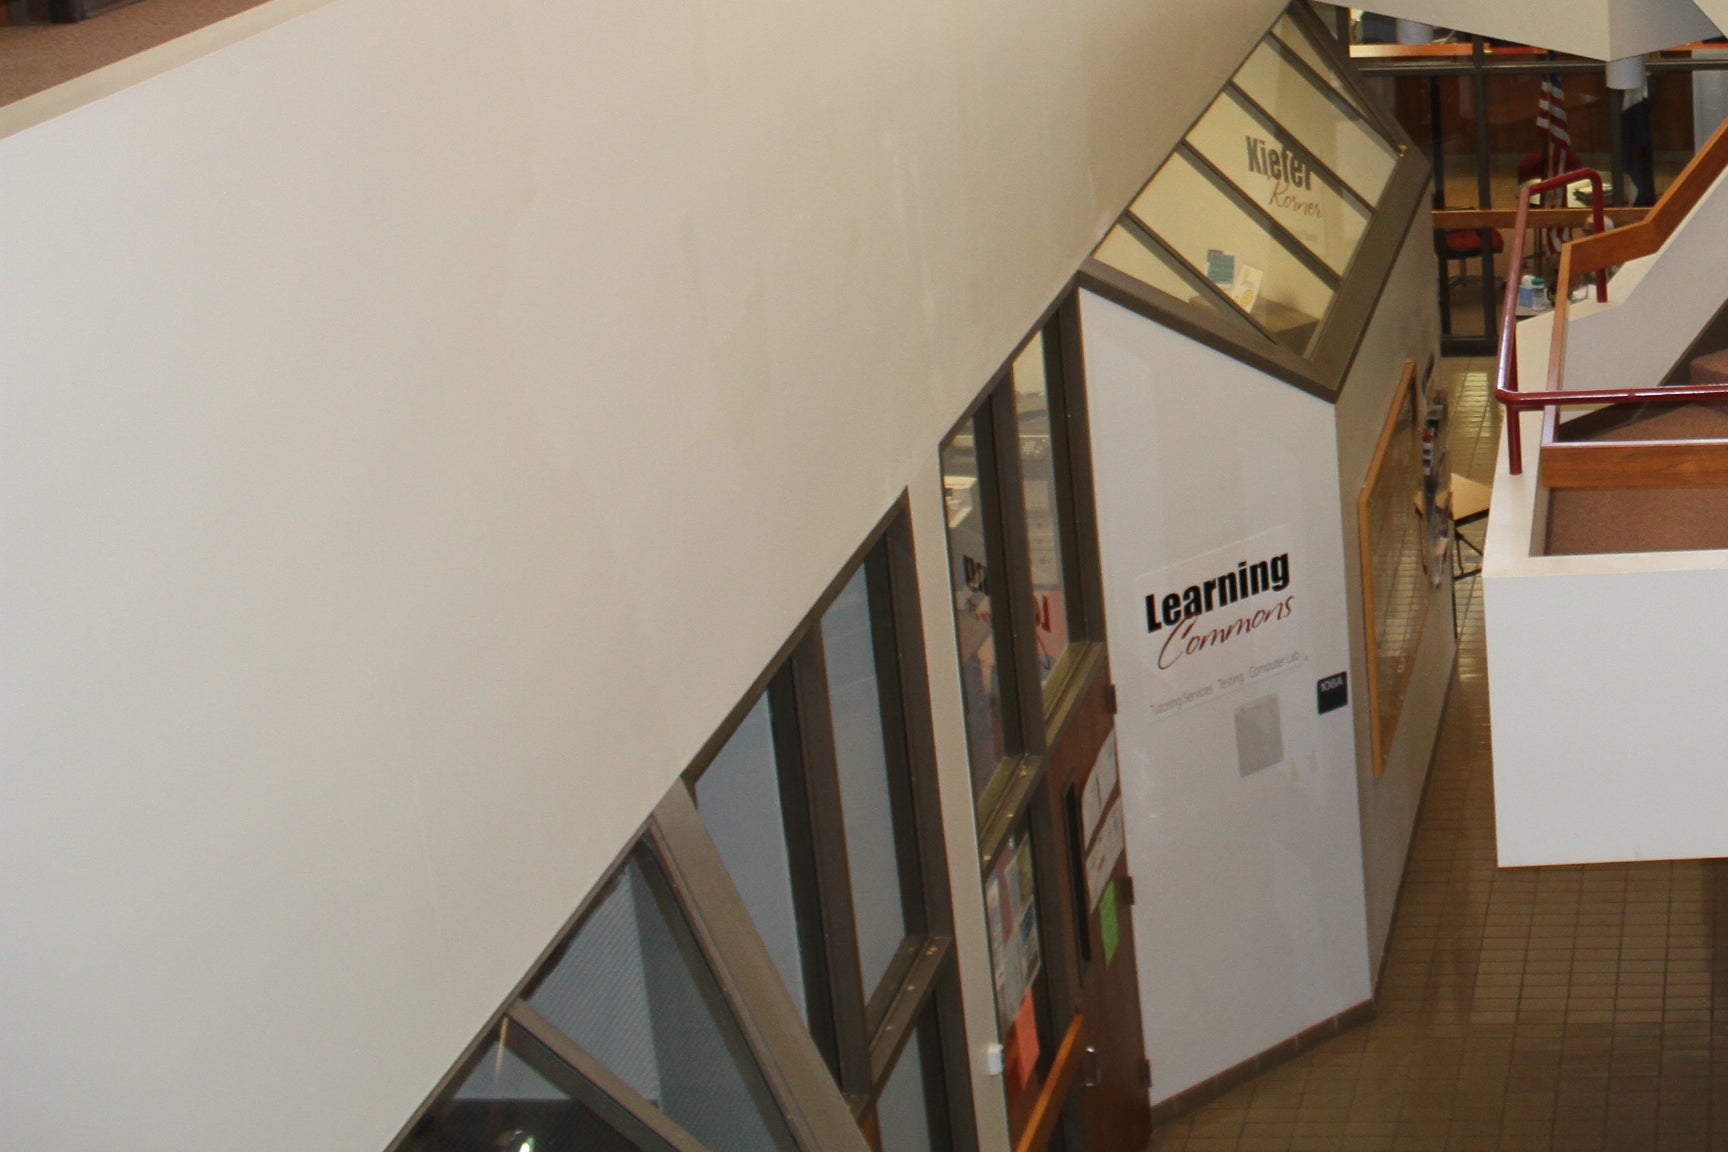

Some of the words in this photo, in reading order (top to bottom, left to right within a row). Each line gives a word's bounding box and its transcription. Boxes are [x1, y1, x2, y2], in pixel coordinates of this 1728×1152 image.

[1245, 135, 1313, 191] Kiefer
[1268, 182, 1322, 218] Korner
[1145, 552, 1290, 634] Learning
[1157, 595, 1295, 670] Commons
